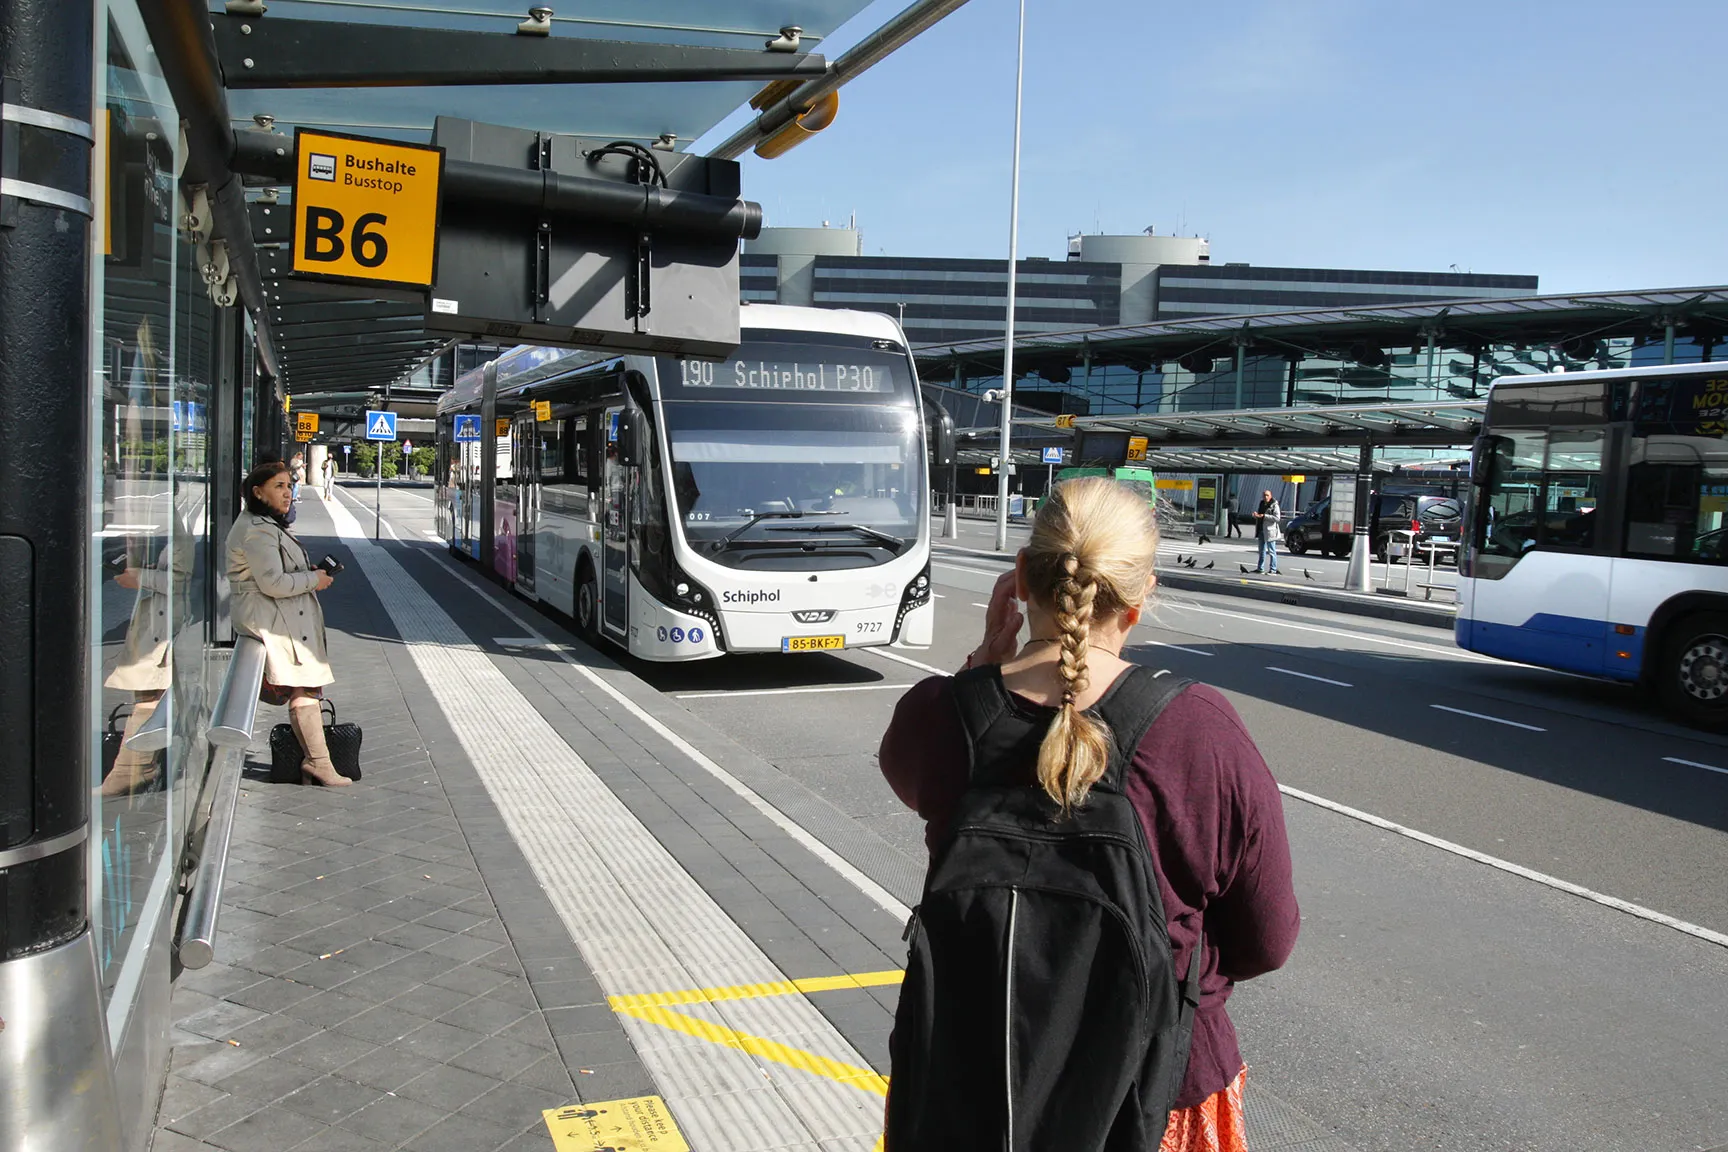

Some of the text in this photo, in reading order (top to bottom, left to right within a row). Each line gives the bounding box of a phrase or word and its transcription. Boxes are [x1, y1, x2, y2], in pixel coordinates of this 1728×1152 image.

[345, 154, 416, 176] Bushalte
[344, 173, 403, 194] Busstop
[304, 206, 388, 268] B6
[680, 360, 873, 391] 190 Schiphol P30
[299, 422, 311, 430] B8
[1128, 449, 1140, 458] B7
[723, 589, 780, 604] Schiphol
[797, 611, 830, 622] VDL
[857, 622, 882, 633] 9727
[791, 637, 840, 649] 85-BKF-7
[628, 1101, 658, 1142] your distance
[644, 1100, 668, 1135] Please keep
